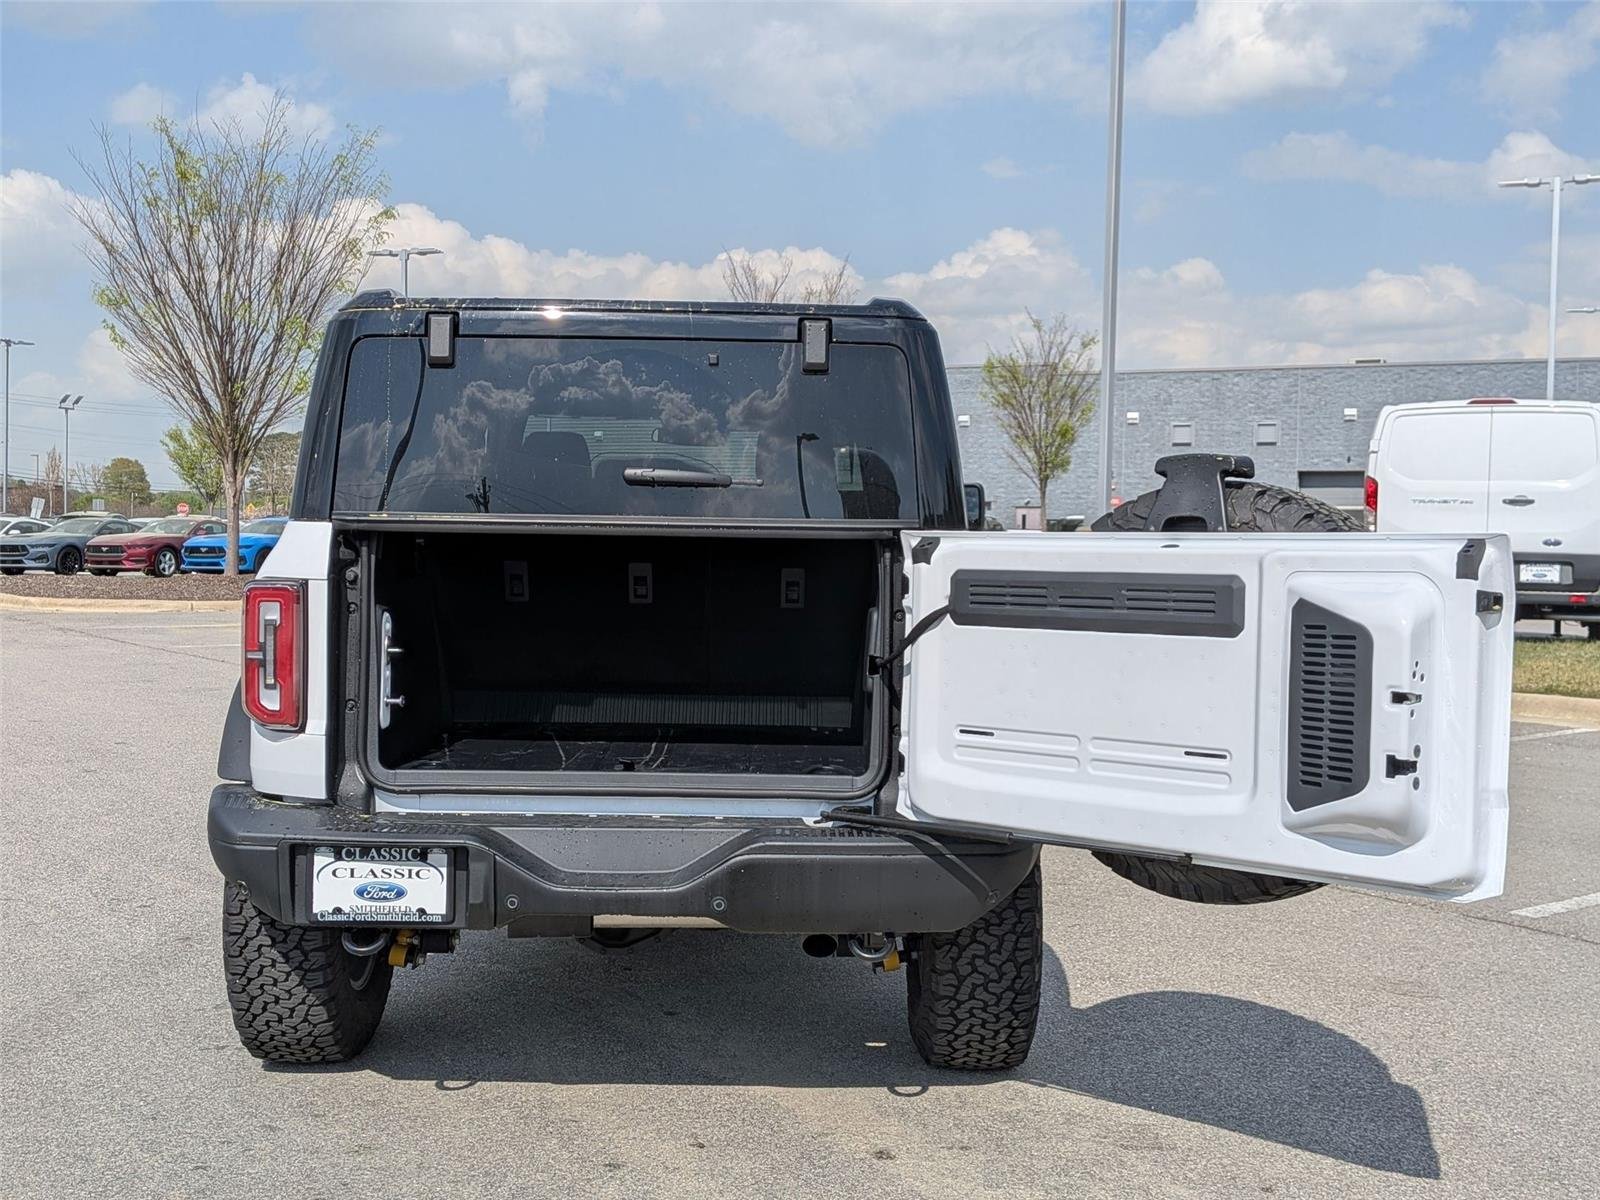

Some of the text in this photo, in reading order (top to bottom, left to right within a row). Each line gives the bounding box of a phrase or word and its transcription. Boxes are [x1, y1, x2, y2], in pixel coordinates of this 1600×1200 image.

[342, 847, 421, 861] CLASSIC
[332, 868, 431, 880] CLASSIC
[363, 884, 398, 899] Ford
[349, 905, 412, 913] SMITHFIELD
[317, 910, 442, 922] ClassicFordSmithfield.com
